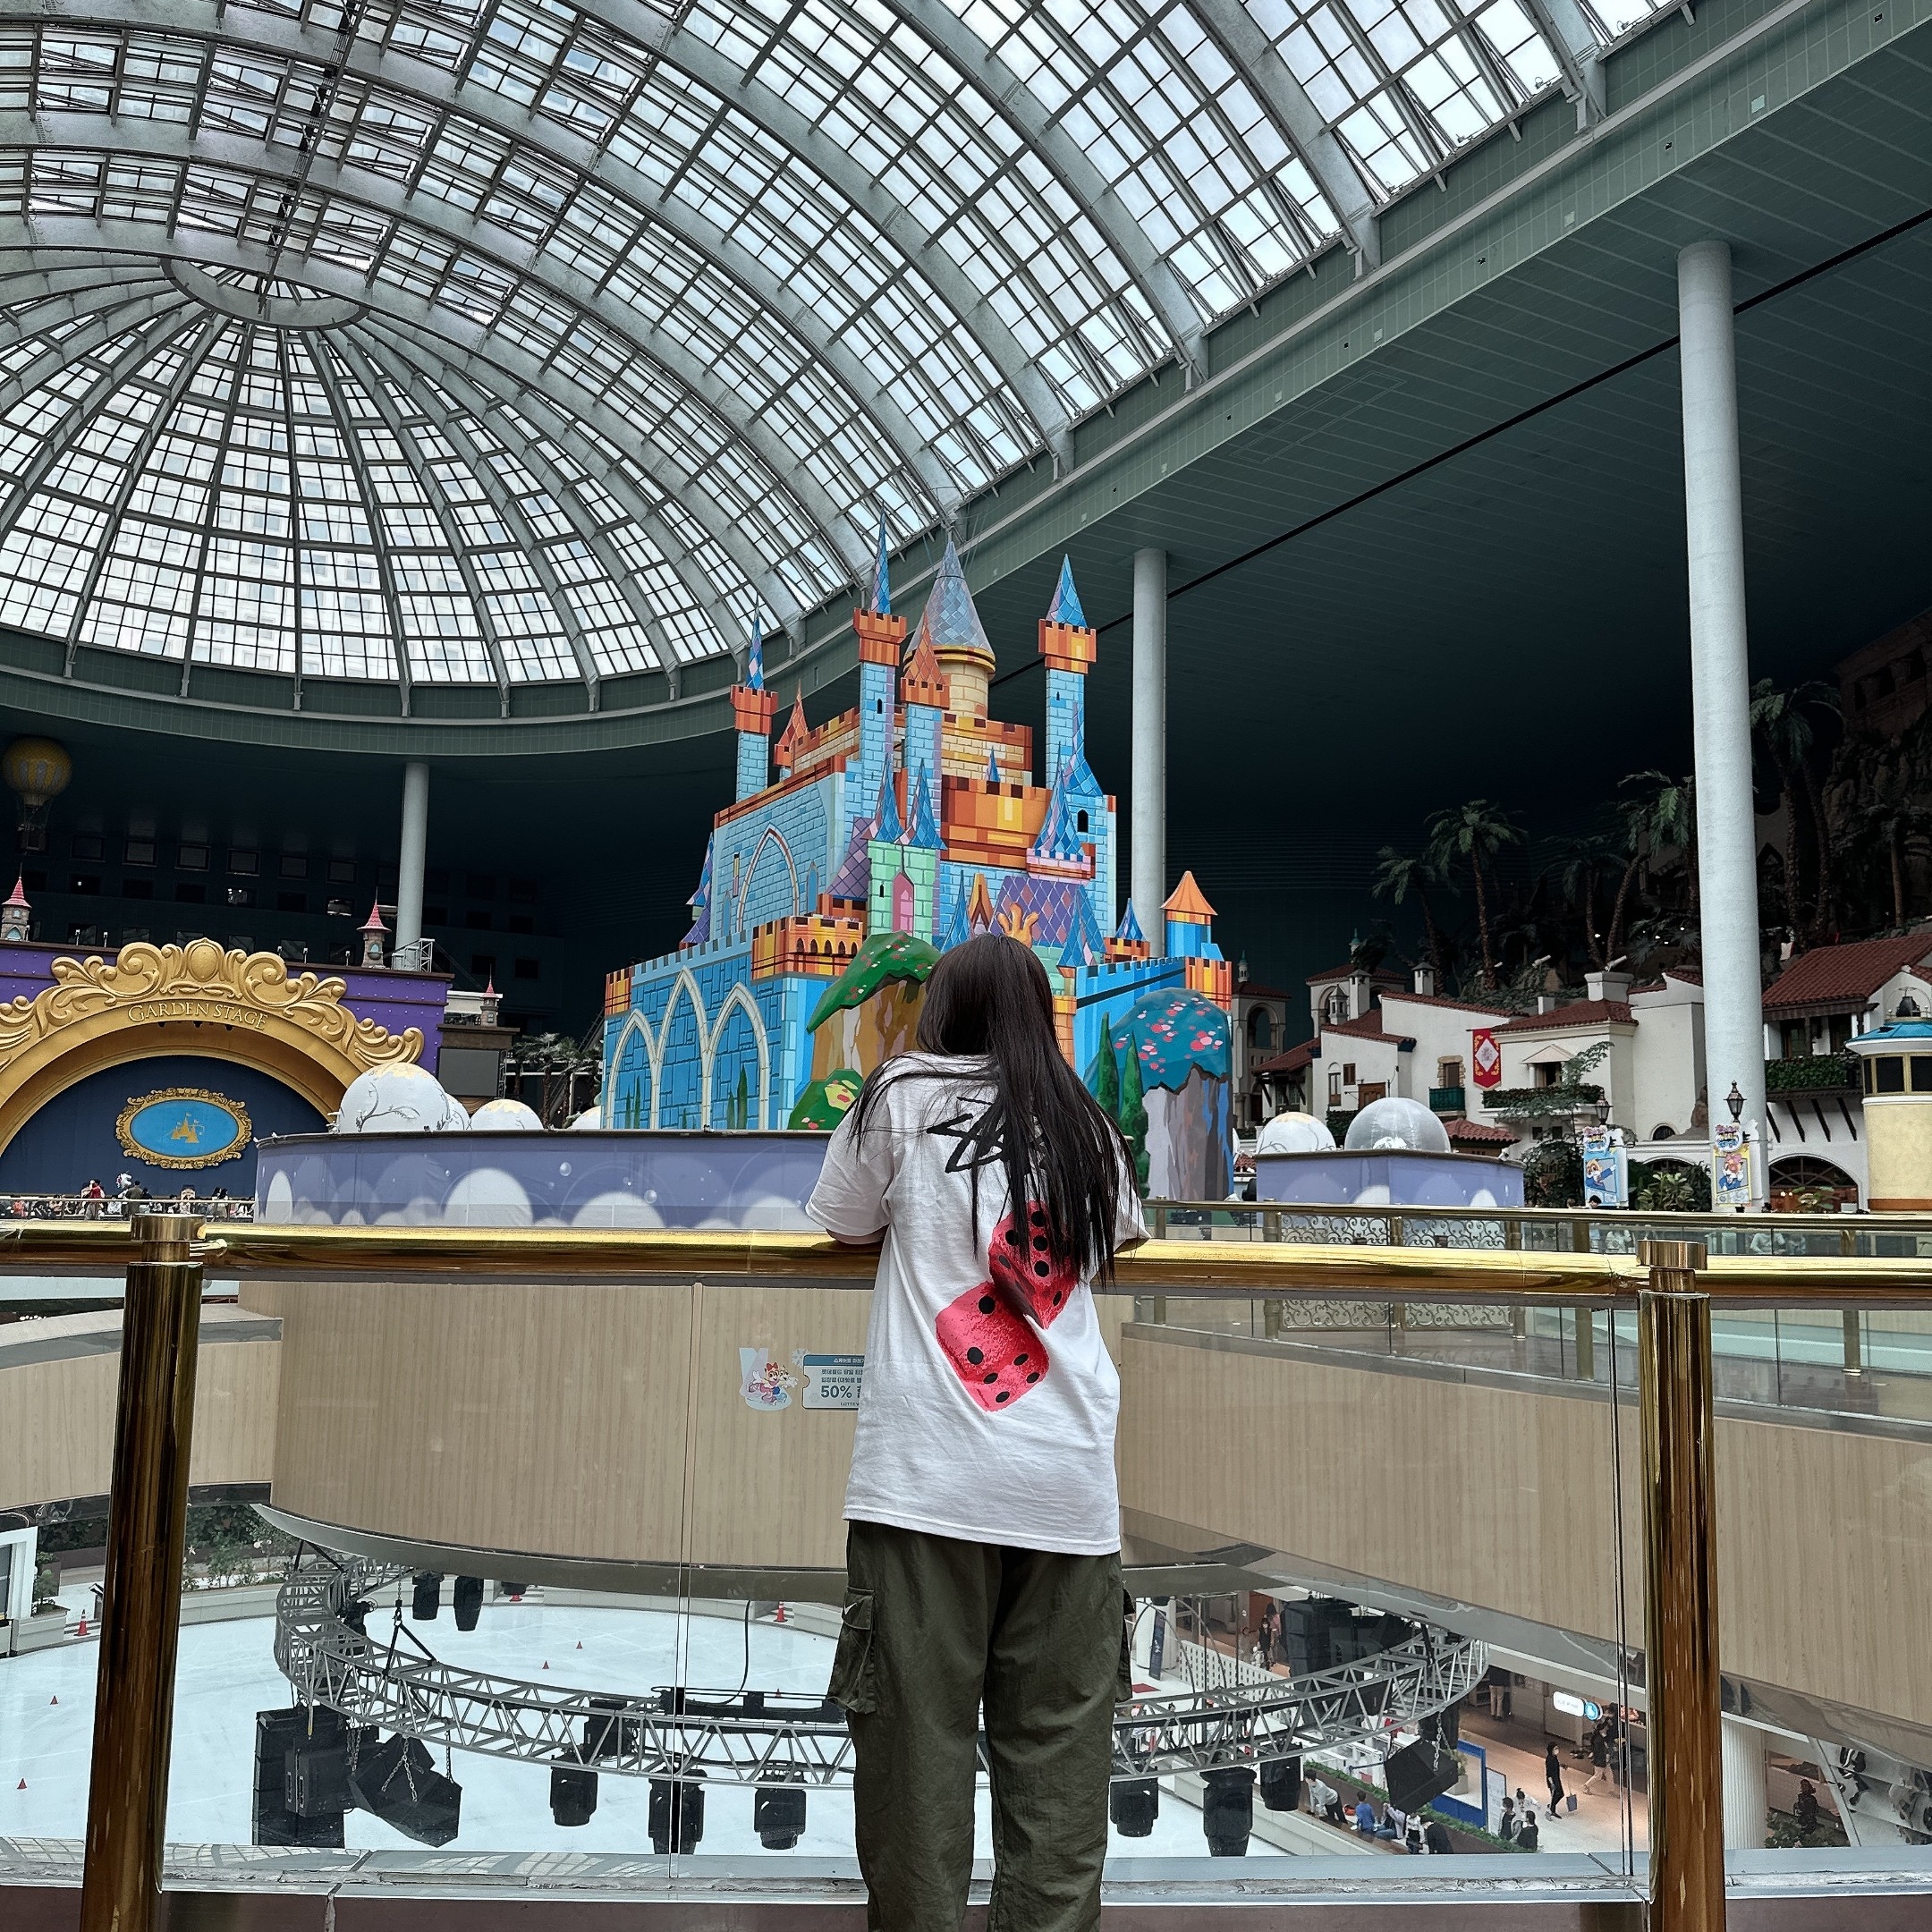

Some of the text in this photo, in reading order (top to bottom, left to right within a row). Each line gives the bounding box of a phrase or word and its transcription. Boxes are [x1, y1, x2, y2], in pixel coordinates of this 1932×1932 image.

[128, 1002, 268, 1030] GARDEN STAGE
[820, 1385, 852, 1398] 50%
